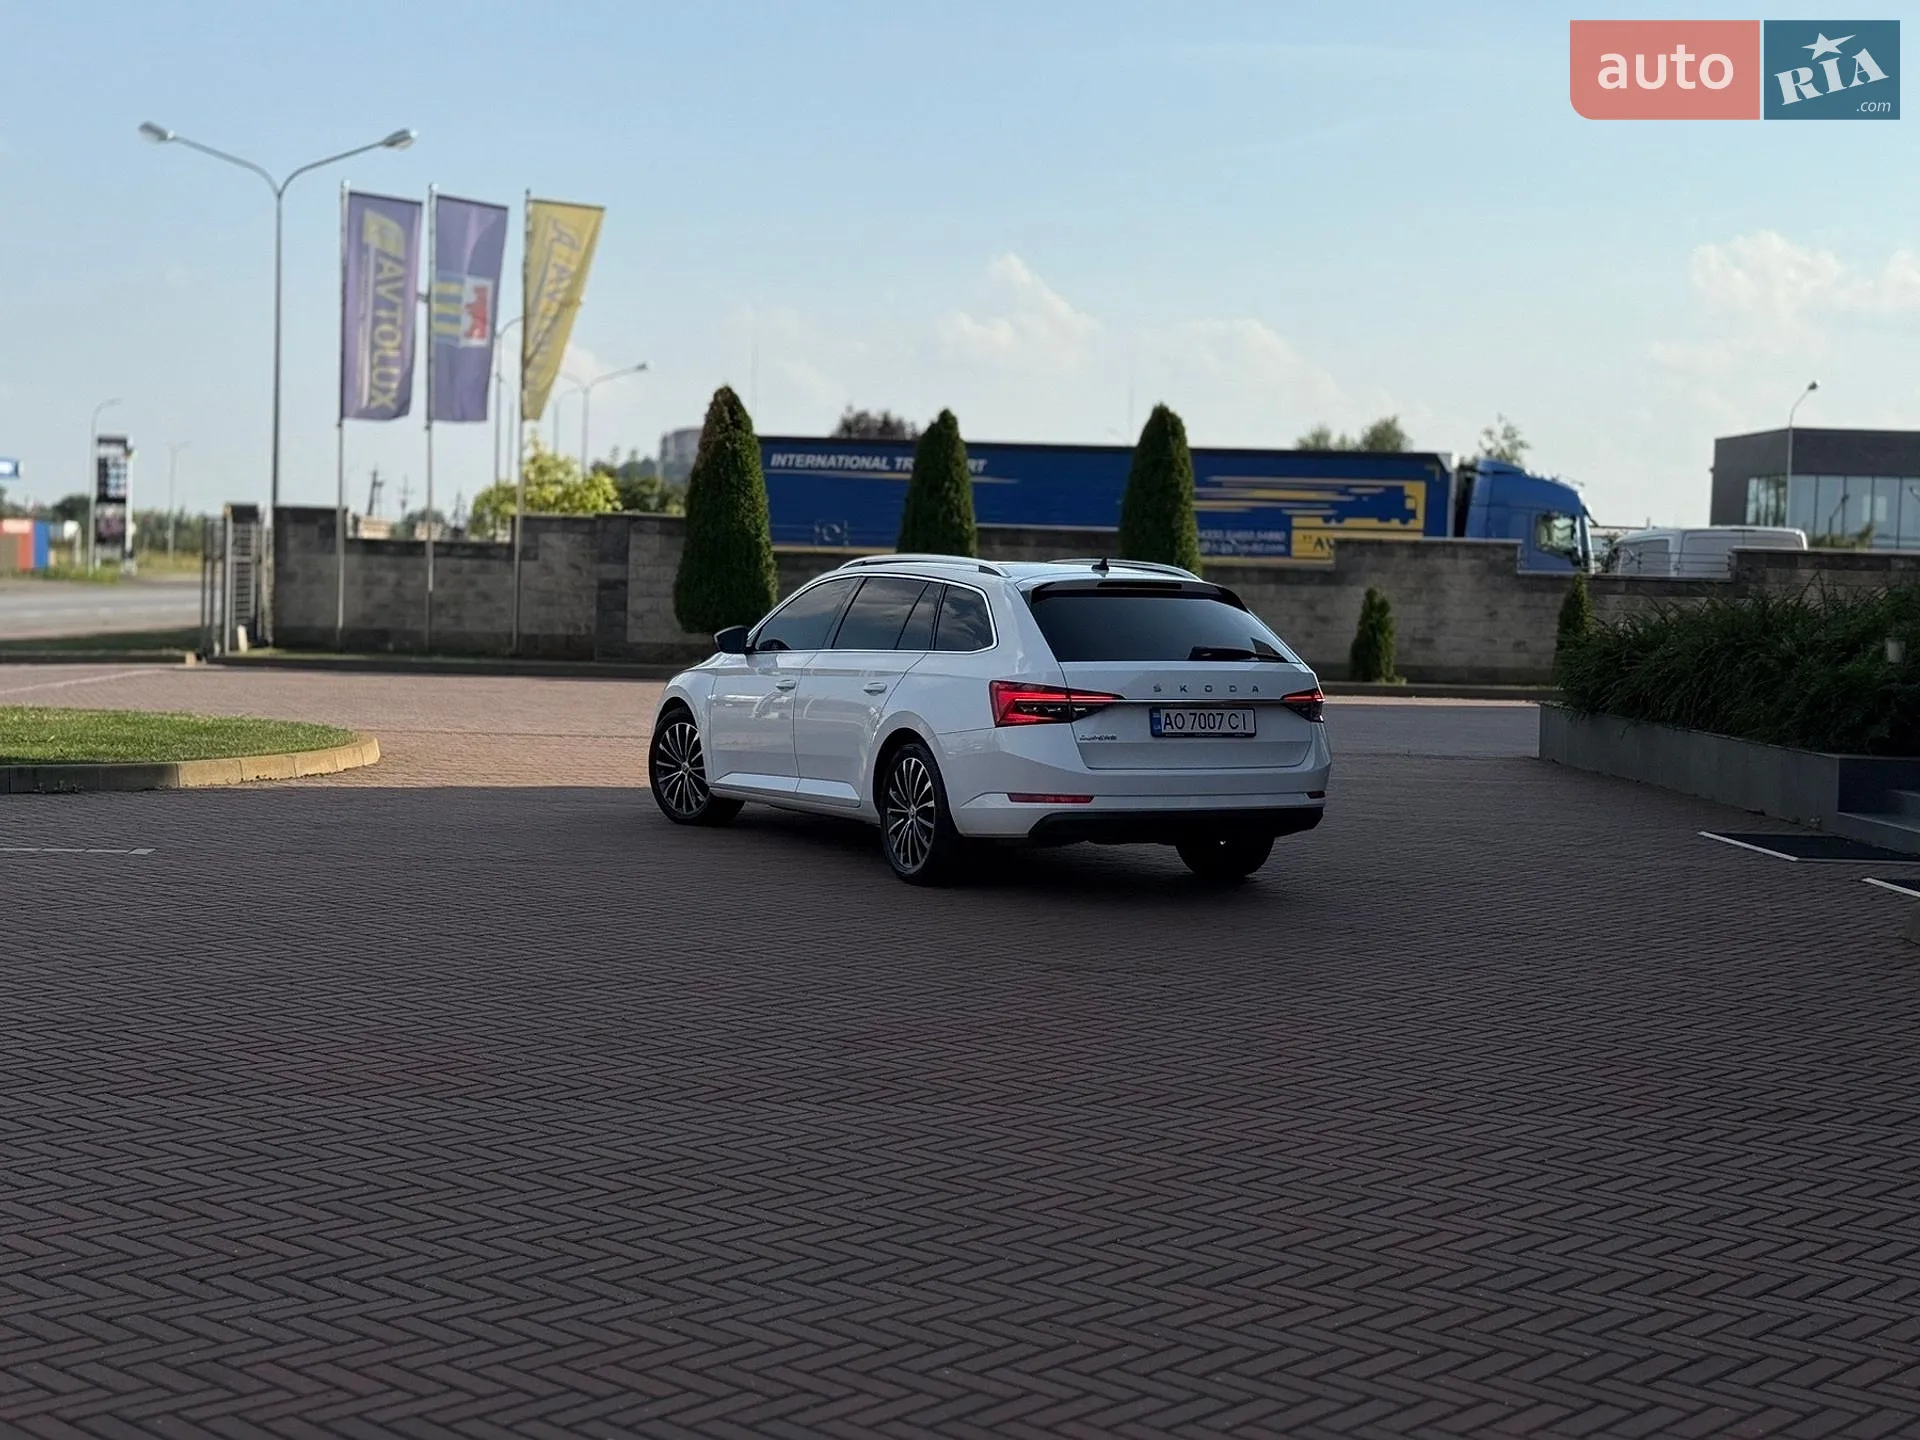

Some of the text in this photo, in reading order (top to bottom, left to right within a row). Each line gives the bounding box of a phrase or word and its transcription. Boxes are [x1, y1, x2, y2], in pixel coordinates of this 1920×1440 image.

[370, 256, 406, 410] AVTOLUX
[770, 453, 891, 470] INTERNATIONAL
[1163, 712, 1247, 730] AO 7007 CI
